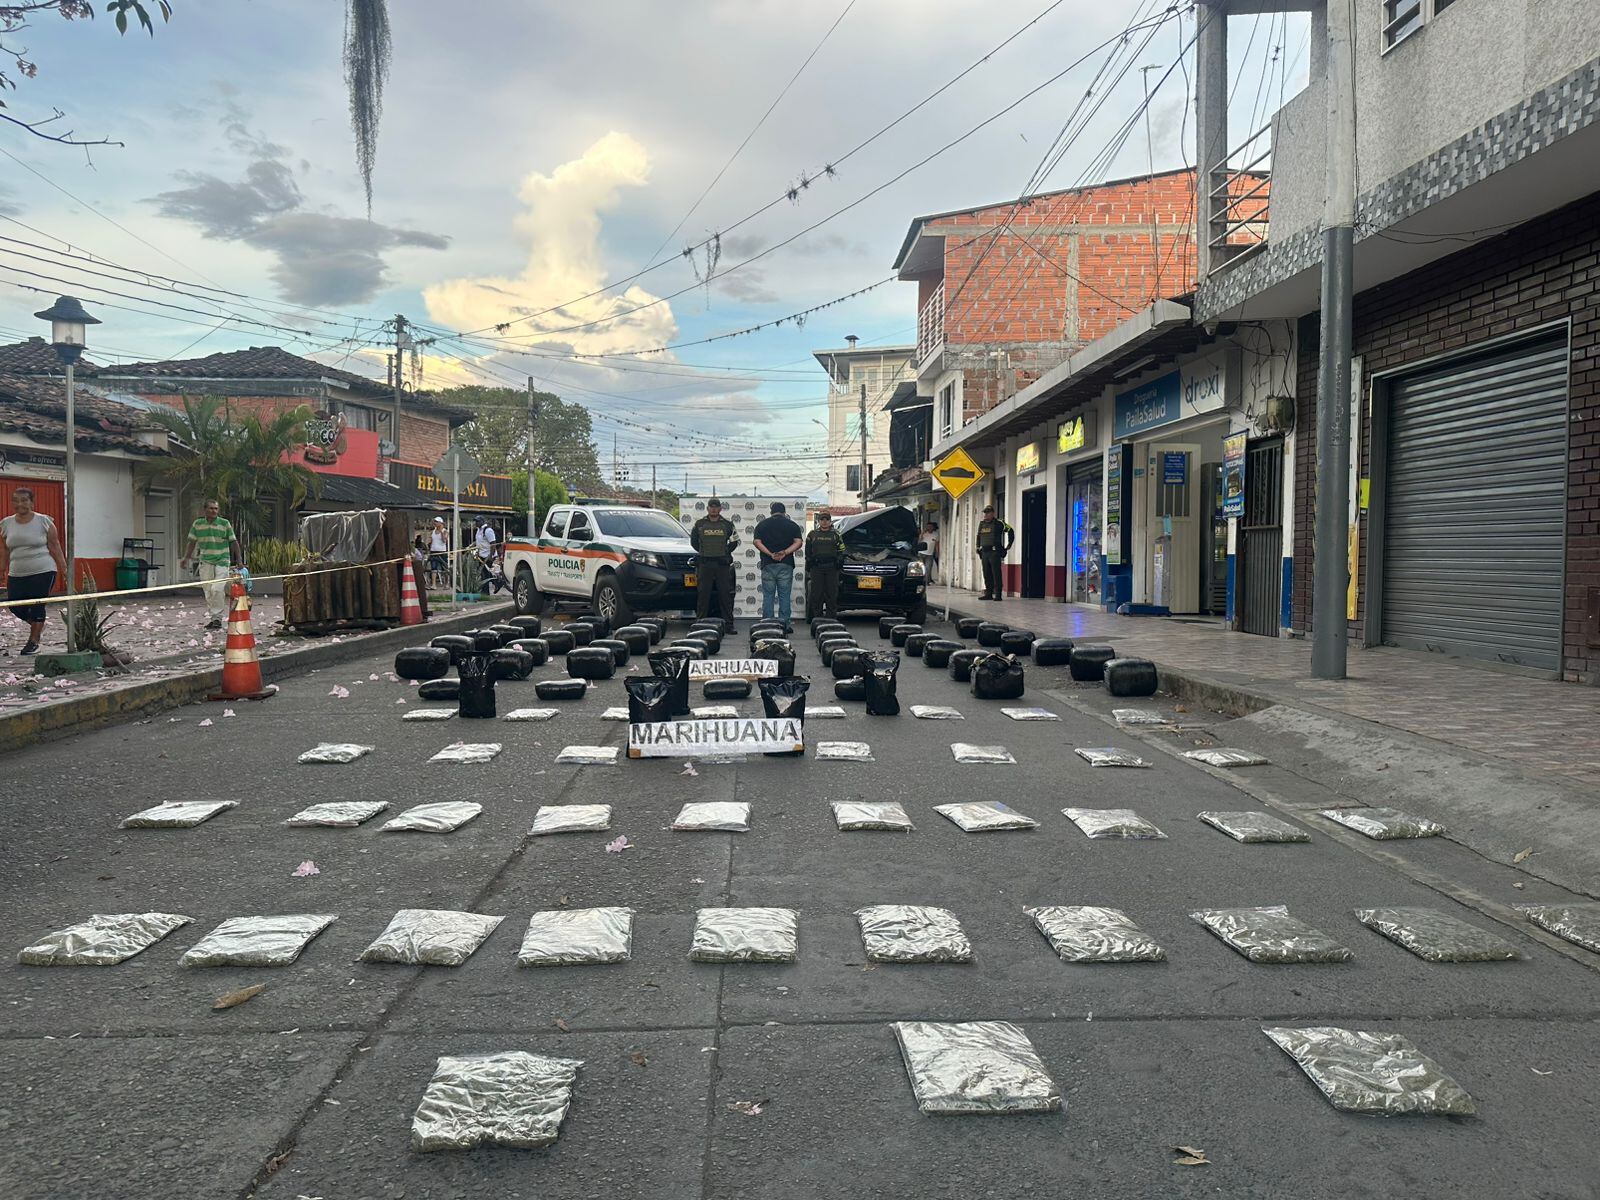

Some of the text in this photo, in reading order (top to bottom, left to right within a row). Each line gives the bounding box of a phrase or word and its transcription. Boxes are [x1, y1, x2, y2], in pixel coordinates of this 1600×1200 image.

[1185, 373, 1219, 404] droxi
[418, 475, 488, 497] HELARIA
[548, 558, 580, 571] POLICIA
[690, 661, 777, 675] ARIHUANA
[631, 718, 800, 745] MARIHUANA
